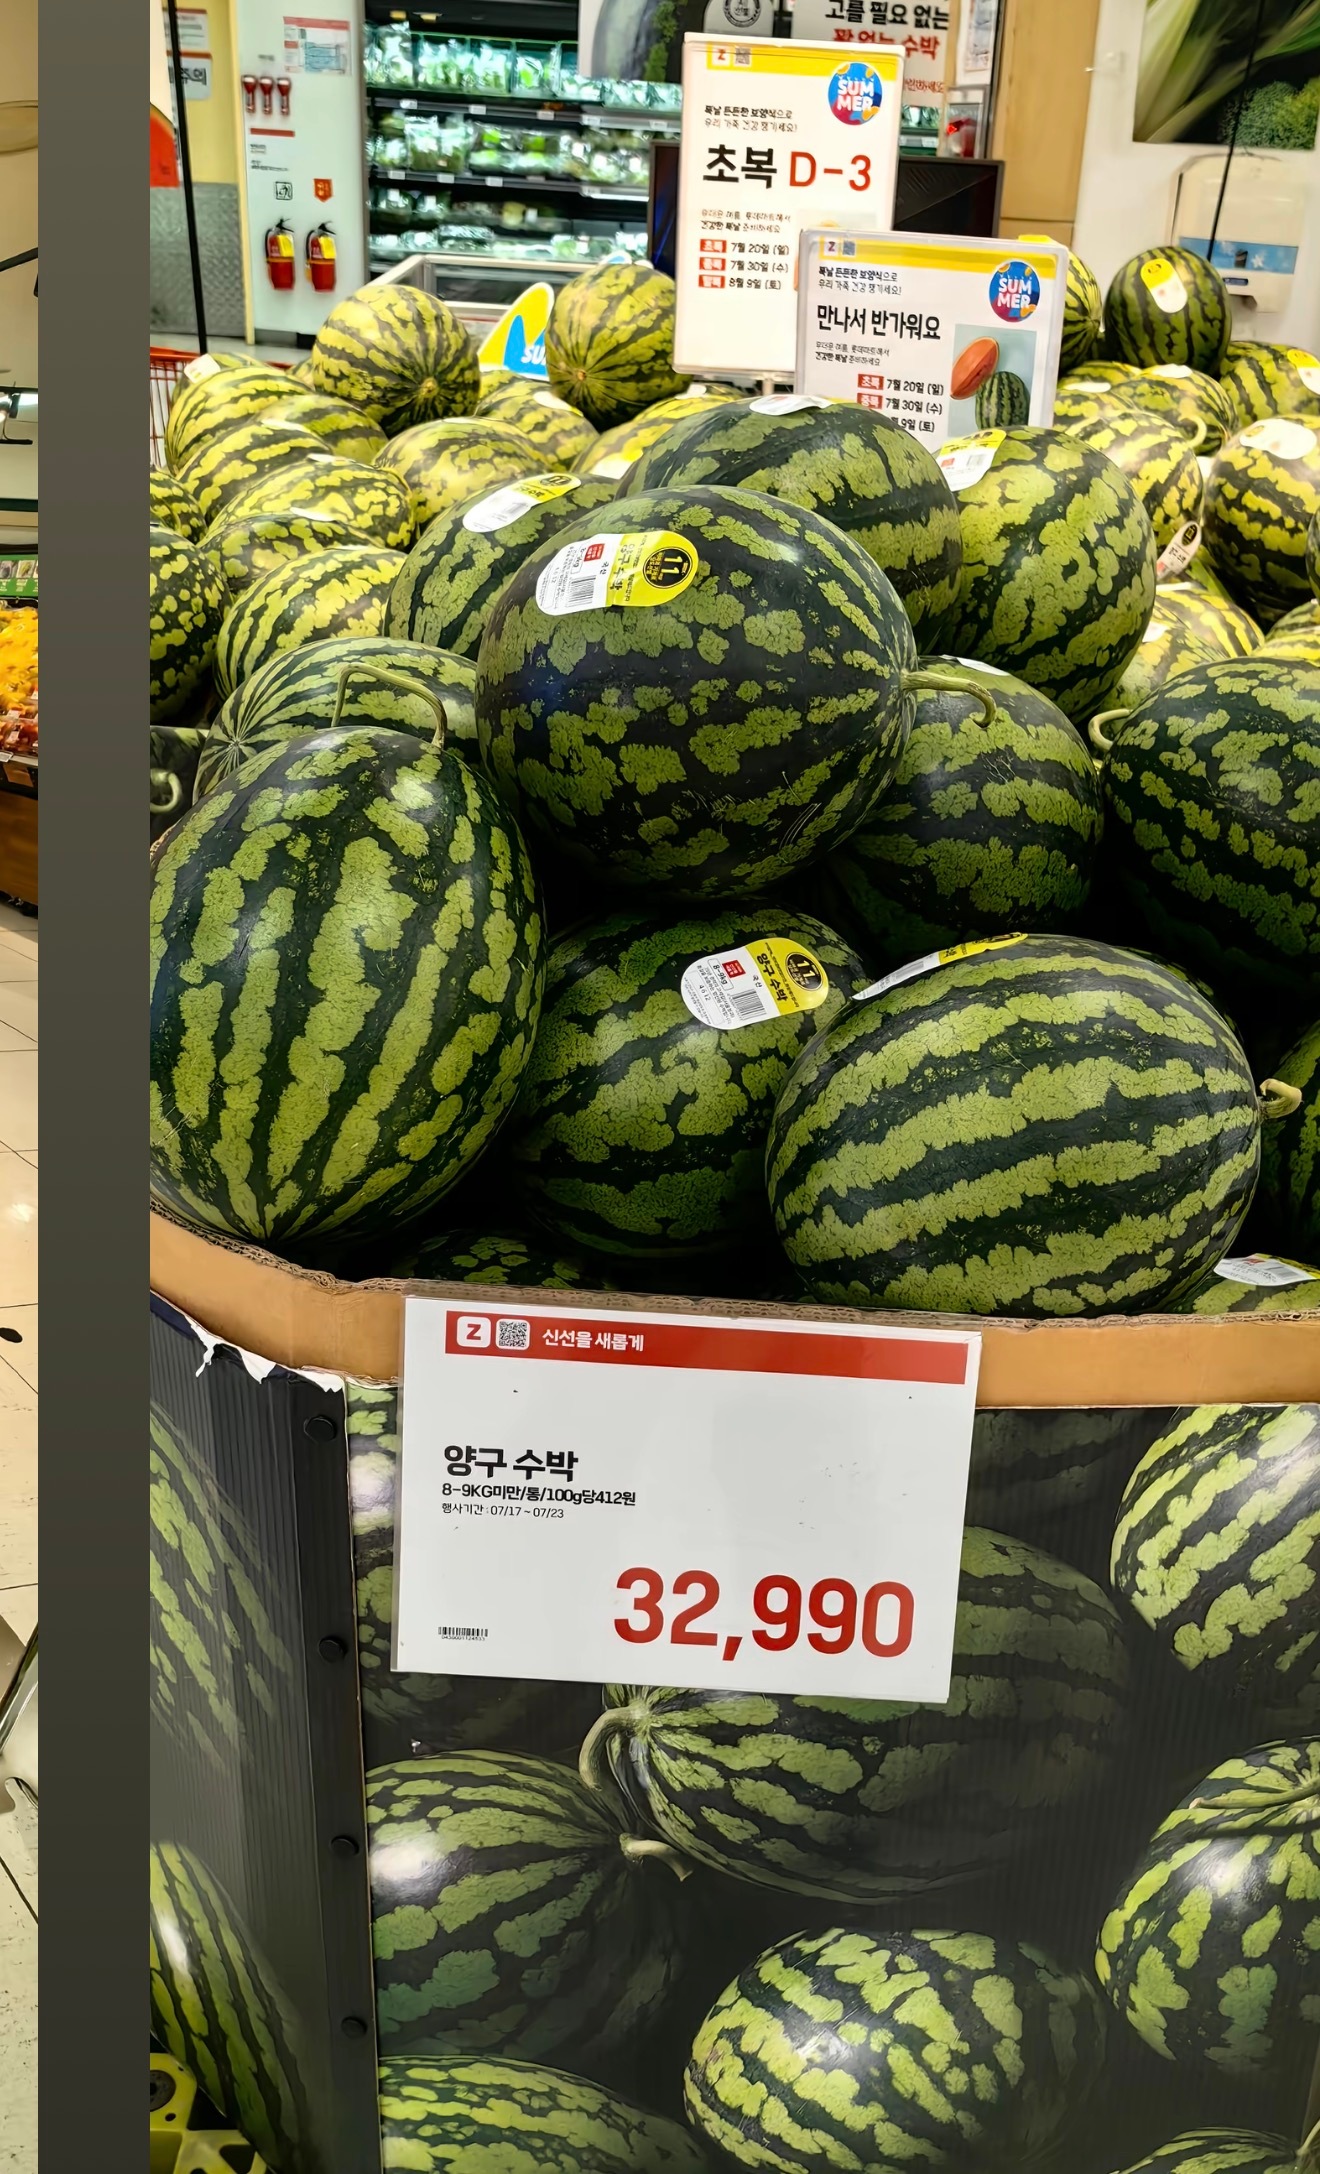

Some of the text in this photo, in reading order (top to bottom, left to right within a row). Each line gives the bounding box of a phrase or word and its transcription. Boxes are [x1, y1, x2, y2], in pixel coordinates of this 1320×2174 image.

[825, 0, 949, 31] 고를 필요 없는
[902, 34, 940, 61] 수박
[838, 79, 874, 97] SUM
[837, 95, 873, 112] MER
[703, 143, 871, 191] 초복 D-3
[999, 277, 1032, 295] SUM
[997, 292, 1031, 309] MER
[817, 305, 940, 340] 만나서 반가워요
[522, 344, 547, 366] SU
[886, 378, 900, 391] 7월
[903, 381, 924, 394] 20일
[927, 383, 944, 396] (일)
[885, 397, 900, 410] 7월
[902, 400, 923, 413] 30일
[926, 402, 942, 415] (수)
[918, 420, 935, 433] (토)
[661, 556, 683, 574] 11
[756, 953, 775, 977] 양구
[770, 978, 788, 1002] 수박
[797, 960, 815, 978] 11
[466, 1323, 644, 1352] Z 신선을 새롭게
[444, 1445, 579, 1483] 양구 수박
[441, 1482, 636, 1506] 8-9KG미만/통/100g당412원
[441, 1503, 484, 1516] 행사기간
[490, 1506, 522, 1517] 07/17
[533, 1508, 564, 1519] 07/23
[614, 1566, 915, 1662] 32,990
